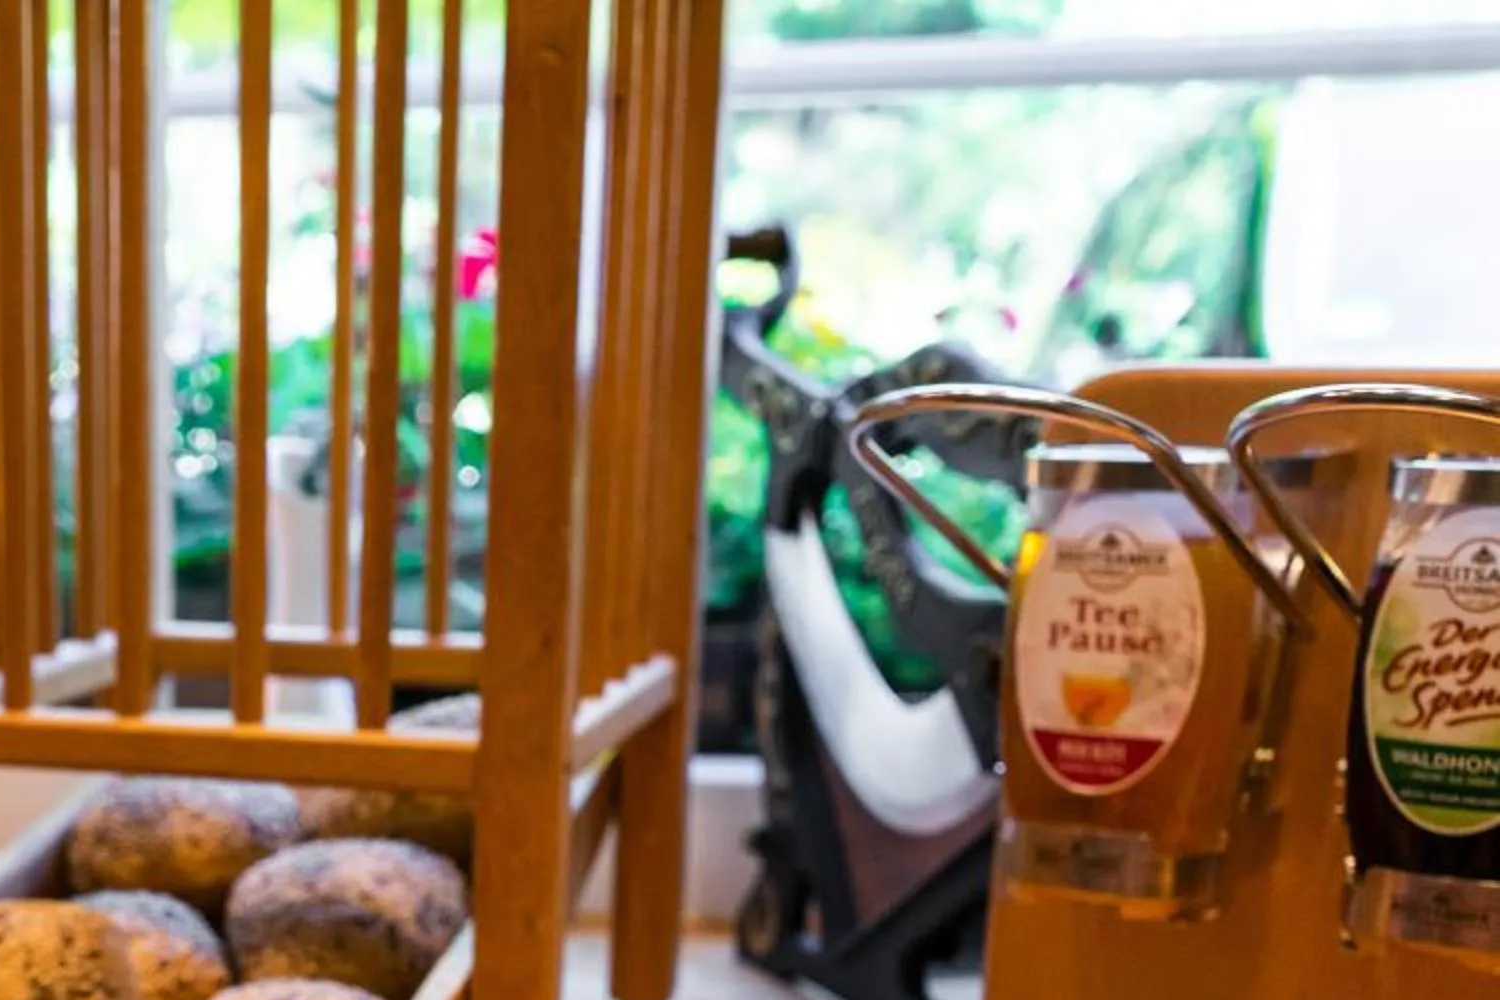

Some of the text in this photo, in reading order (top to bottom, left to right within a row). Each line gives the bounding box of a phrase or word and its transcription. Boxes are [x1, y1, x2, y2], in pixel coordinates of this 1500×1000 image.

[1070, 595, 1141, 626] Tee
[1429, 617, 1500, 649] Der
[1392, 680, 1500, 731] Spen
